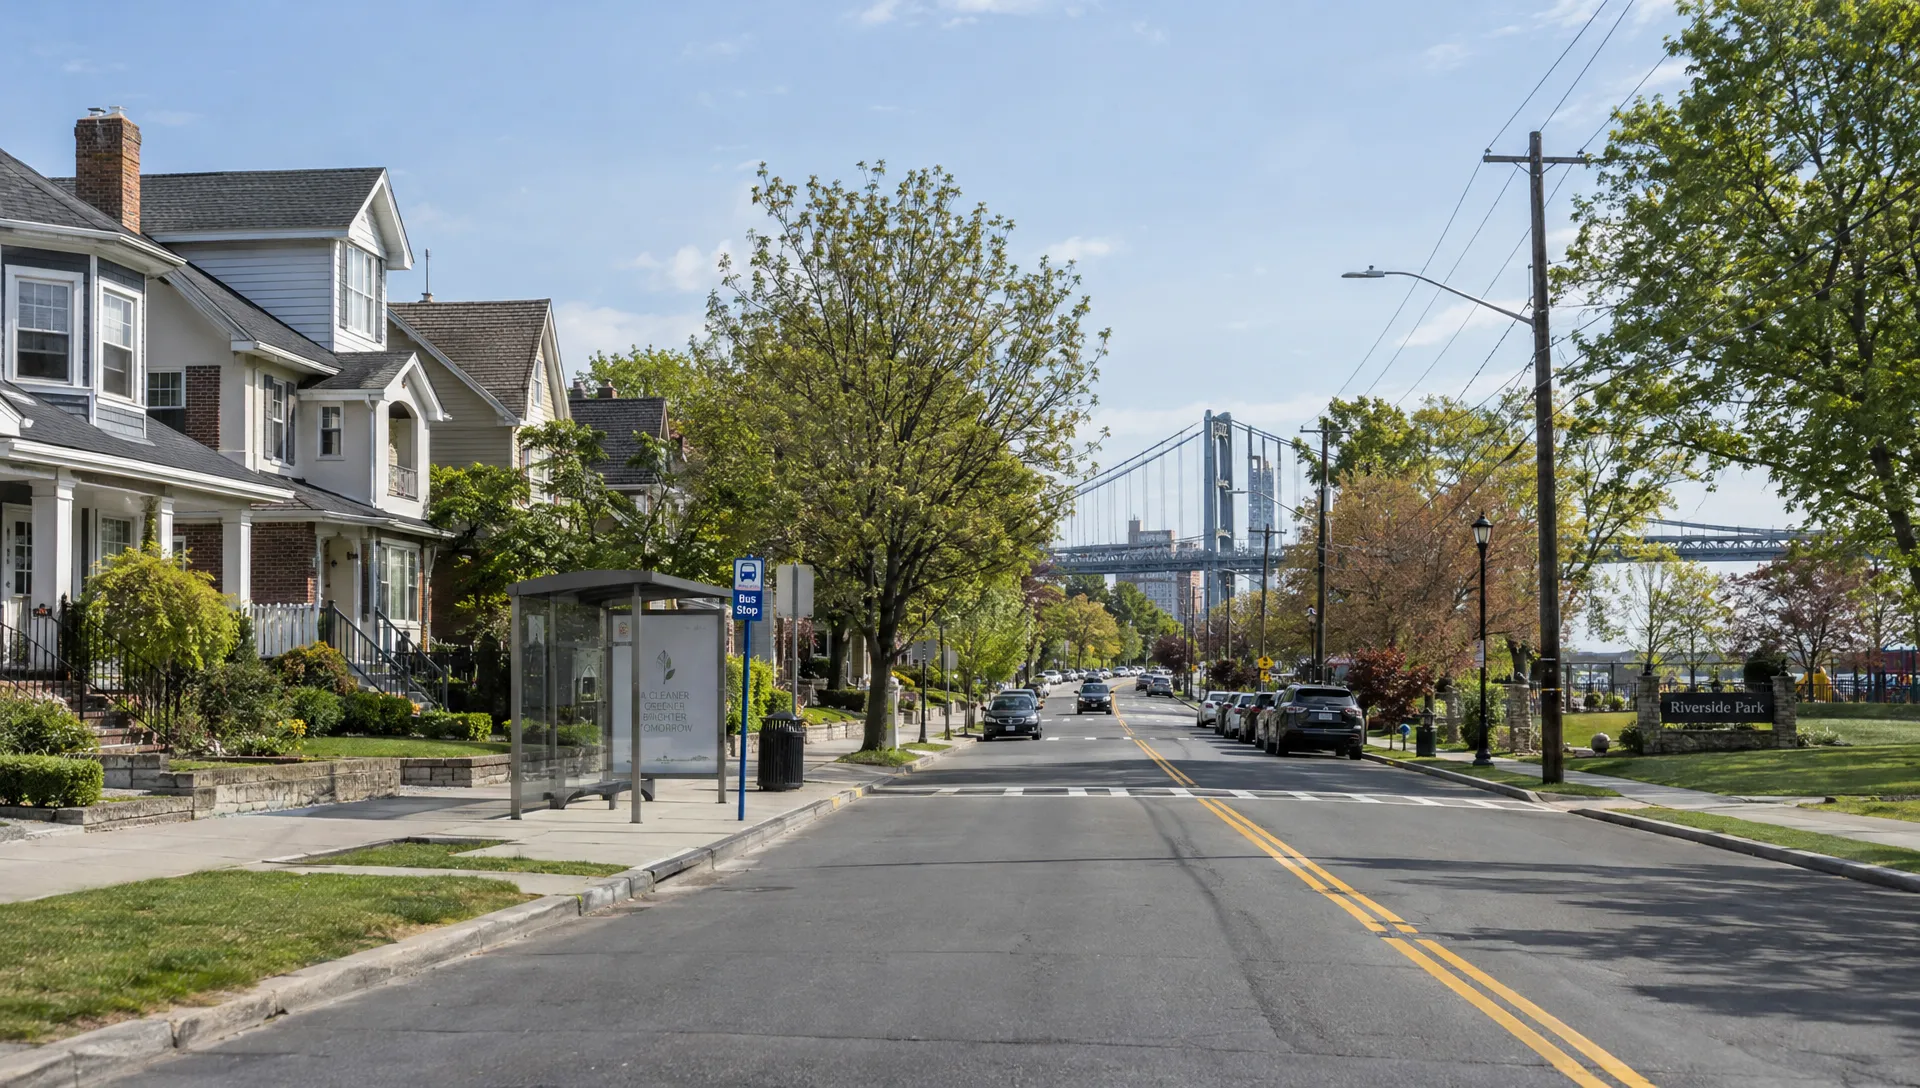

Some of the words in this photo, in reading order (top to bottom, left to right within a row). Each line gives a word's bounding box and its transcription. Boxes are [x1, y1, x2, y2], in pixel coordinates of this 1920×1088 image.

[739, 594, 756, 604] Bus
[736, 605, 758, 616] Stop
[649, 691, 690, 700] CLEANER
[1671, 701, 1731, 713] Riverside
[1735, 701, 1764, 713] Park
